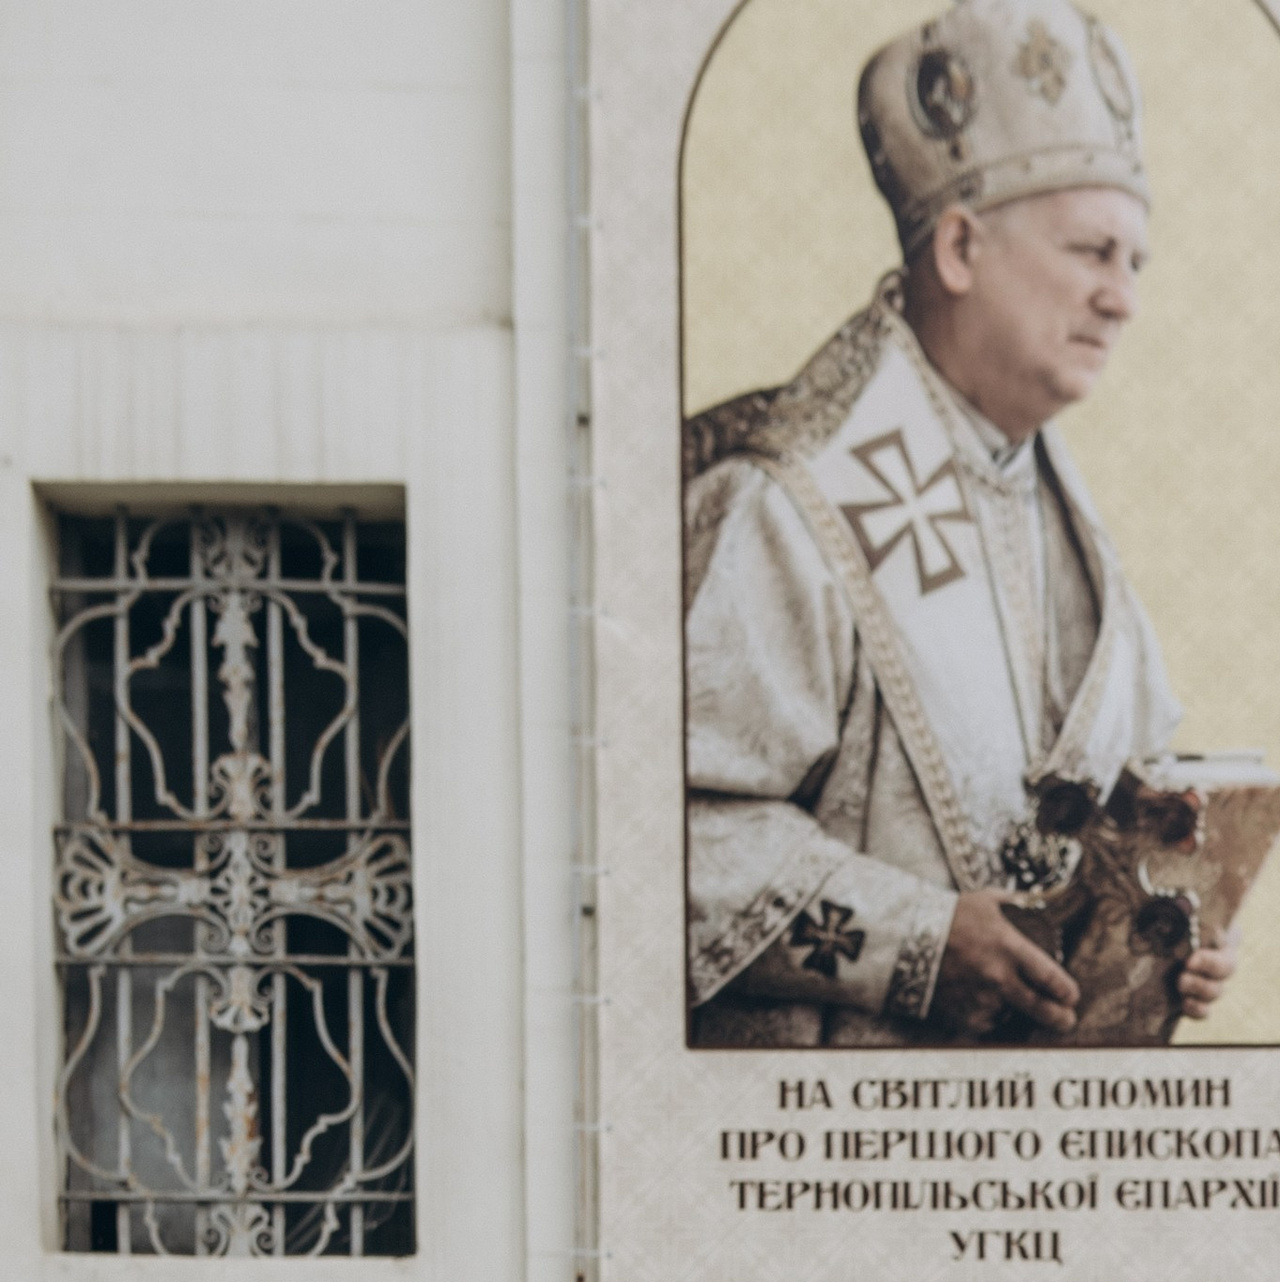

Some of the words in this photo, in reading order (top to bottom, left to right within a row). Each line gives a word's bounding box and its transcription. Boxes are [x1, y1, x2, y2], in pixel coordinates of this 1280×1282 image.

[777, 1077, 834, 1111] НА
[850, 1071, 1036, 1111] СВІТЛИЙ
[1051, 1076, 1232, 1110] СПОМИН
[719, 1129, 807, 1162] ПРО
[823, 1128, 1043, 1162] ПЕРШОГО
[728, 1173, 1100, 1212] ТЕРНОПІЛЬСЬКОЇ
[949, 1229, 1064, 1266] УГКЦ
